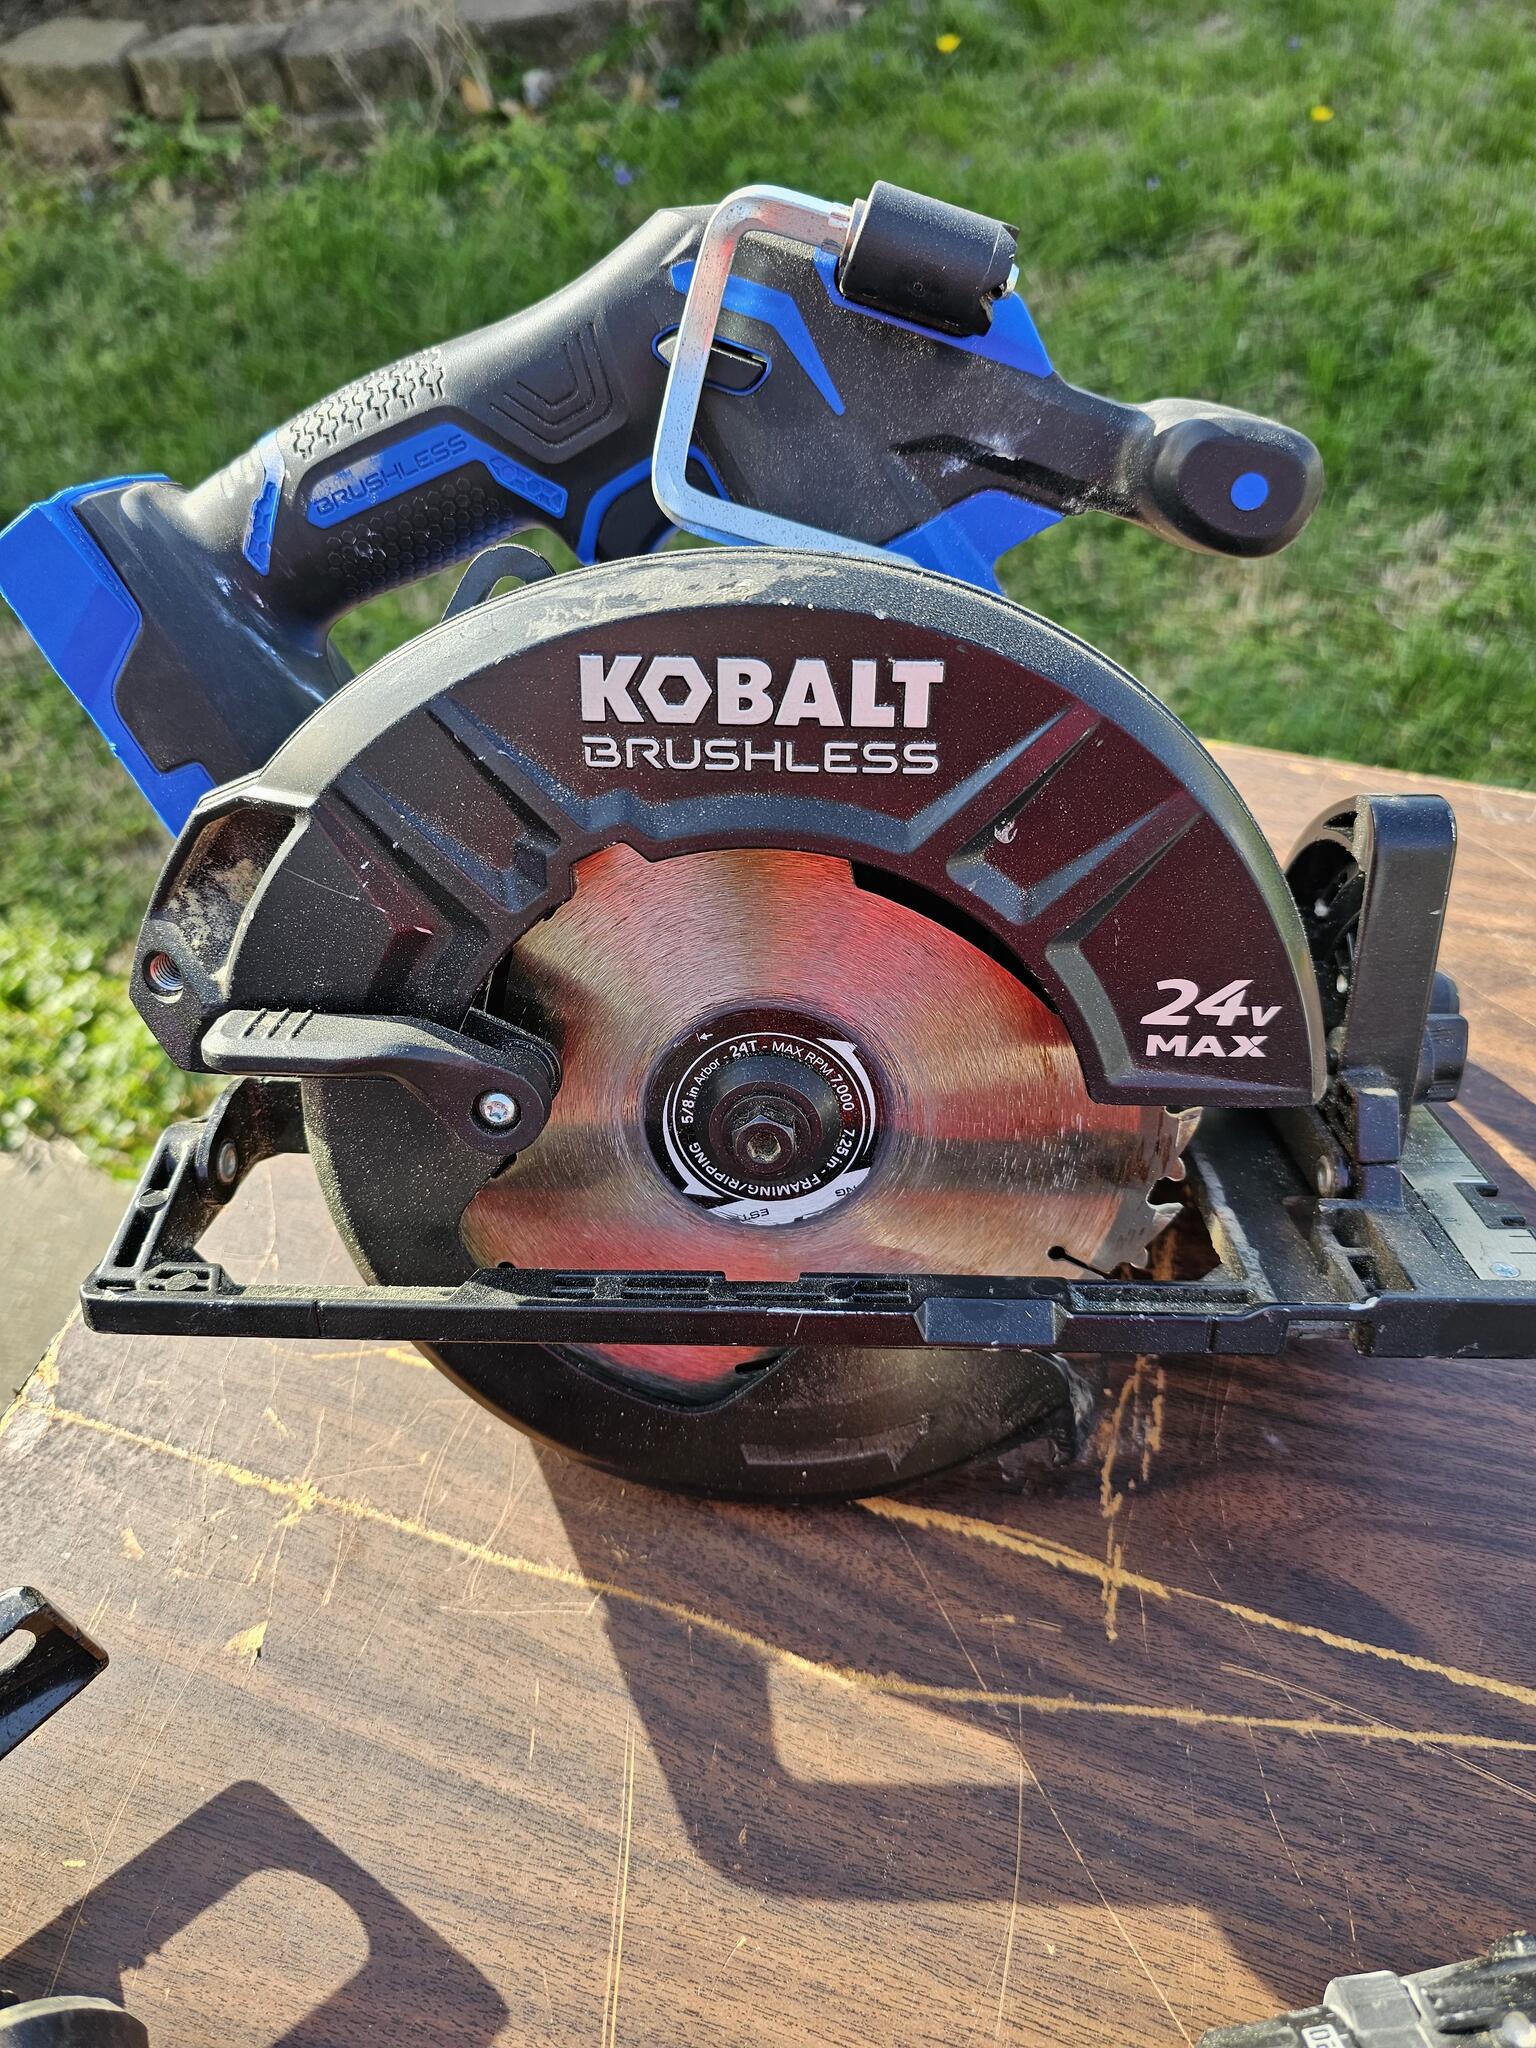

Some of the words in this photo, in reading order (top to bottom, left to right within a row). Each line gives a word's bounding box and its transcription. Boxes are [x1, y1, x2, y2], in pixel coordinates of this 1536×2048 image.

[313, 433, 468, 515] BRUSHLESS
[579, 654, 945, 729] KOBALT
[581, 735, 940, 775] BRUSHLESS
[1145, 1034, 1269, 1058] MAX
[681, 1099, 695, 1124] 5/8
[693, 1058, 721, 1086] Arbor
[729, 1039, 758, 1058] 24T
[772, 1040, 805, 1057] MAX
[804, 1051, 834, 1077] RPM
[830, 1073, 855, 1111] 7,000
[826, 1156, 843, 1169] in
[836, 1128, 856, 1156] 7.25
[688, 1142, 822, 1197] FRAMING/RIPPING
